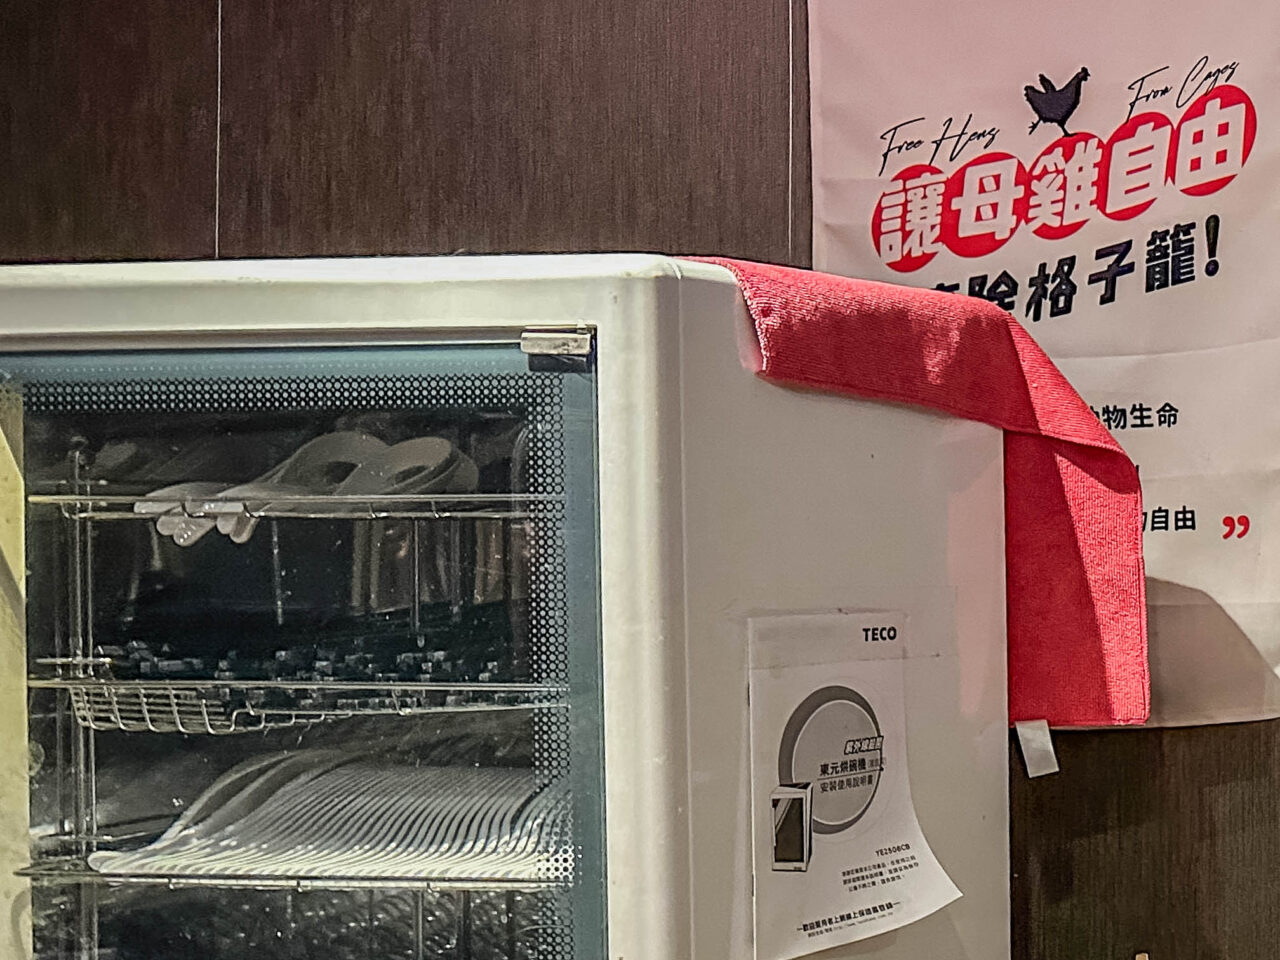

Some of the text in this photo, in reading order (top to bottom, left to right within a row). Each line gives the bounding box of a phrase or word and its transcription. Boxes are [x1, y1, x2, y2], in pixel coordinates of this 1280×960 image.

[877, 97, 1248, 265] 讓母雞自由
[879, 117, 925, 176] Free
[931, 213, 1222, 323] 除格子籠!
[862, 626, 897, 642] TECO
